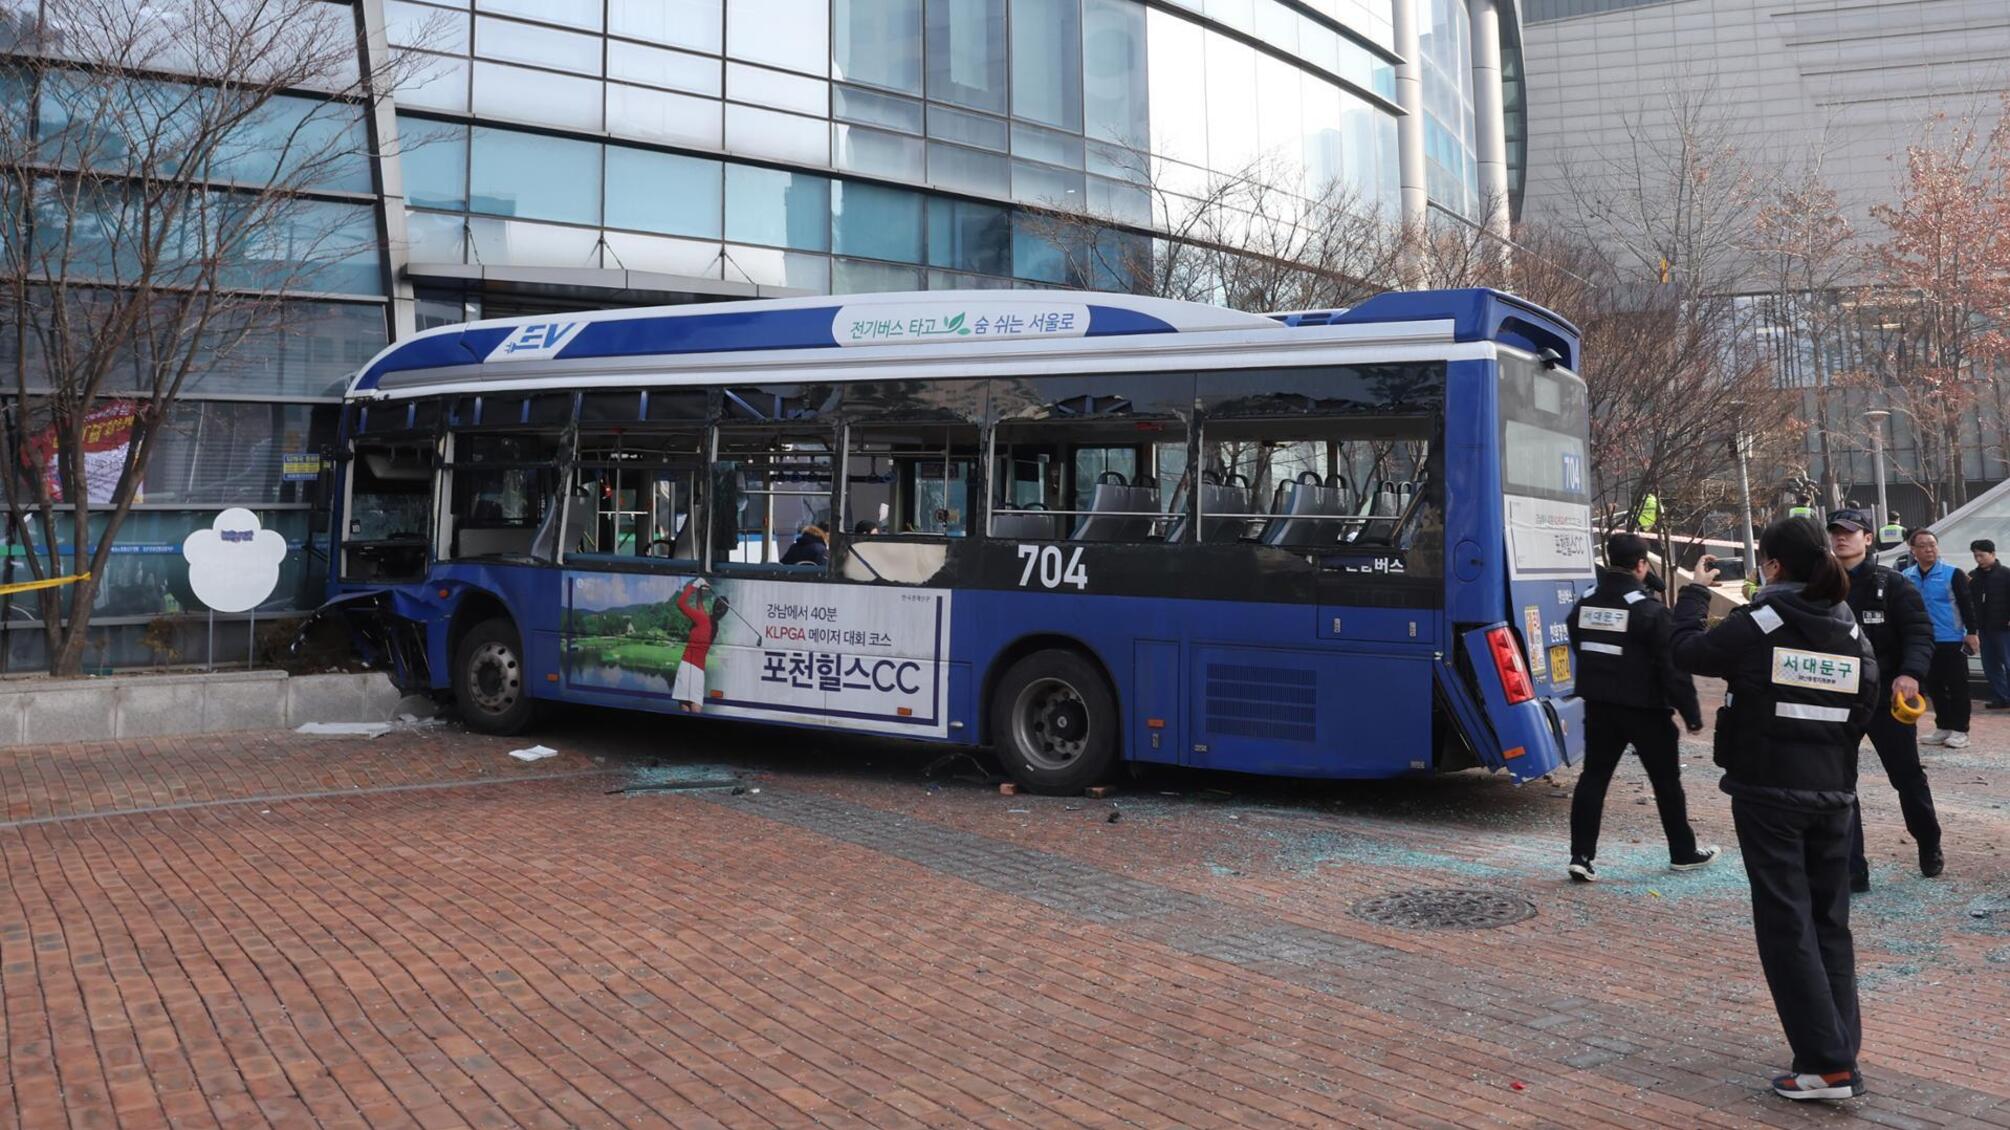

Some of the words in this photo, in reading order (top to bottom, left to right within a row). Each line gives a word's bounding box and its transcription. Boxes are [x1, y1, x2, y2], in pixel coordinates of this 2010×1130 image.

[515, 322, 577, 352] EV
[850, 320, 903, 339] 전기버스
[909, 317, 936, 336] 타고
[974, 315, 990, 334] 숨
[994, 314, 1024, 333] 쉬는
[1028, 312, 1075, 333] 서울로
[1563, 455, 1581, 490] 704
[1017, 544, 1088, 590] 704
[767, 603, 808, 621] 강남에서
[810, 606, 837, 622] 40분
[765, 625, 806, 641] KLPGA
[808, 627, 840, 645] 메이저
[843, 631, 866, 647] 대회
[868, 632, 892, 647] 코스
[761, 651, 921, 695] 포천힐스CC
[1784, 656, 1852, 679] 서대문구
